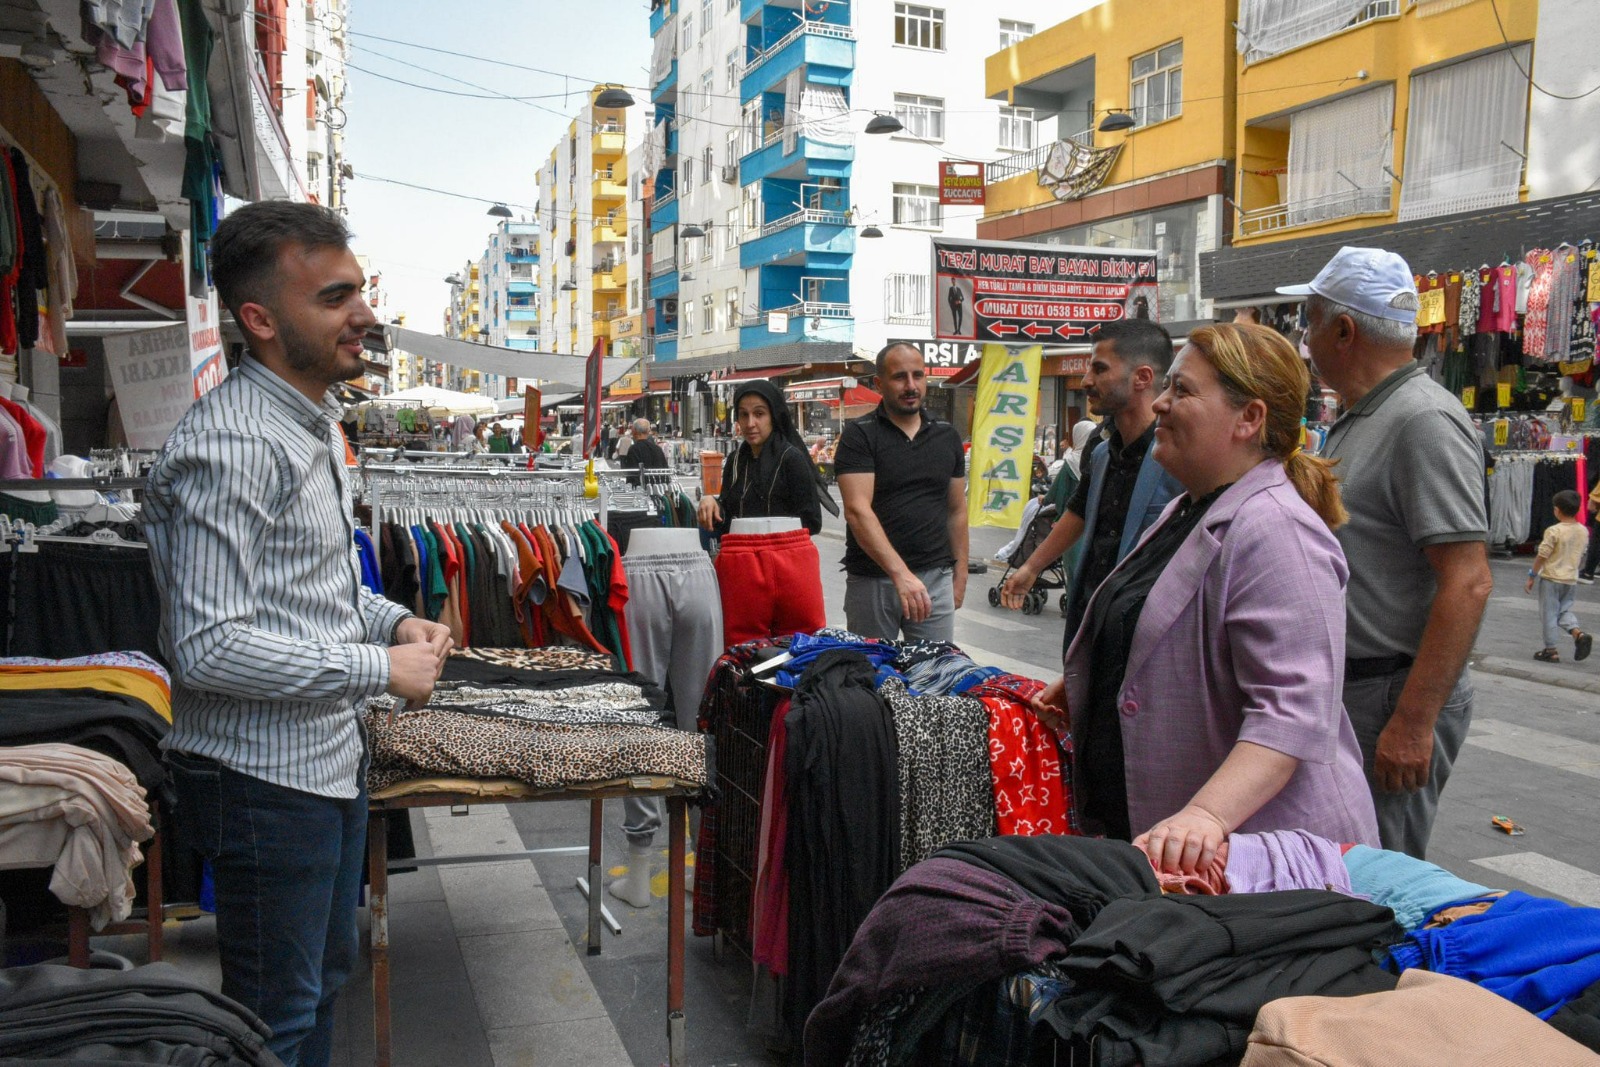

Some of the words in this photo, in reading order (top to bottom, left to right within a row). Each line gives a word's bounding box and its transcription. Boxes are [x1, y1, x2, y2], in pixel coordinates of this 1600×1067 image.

[938, 249, 977, 270] TERZİ
[980, 253, 1026, 272] MURAT
[1029, 256, 1055, 274] BAY
[1058, 257, 1099, 276] BAYAN
[1101, 258, 1136, 278] DİKİM
[977, 280, 989, 289] HER
[990, 280, 1007, 291] TÜRLÜ
[983, 302, 1018, 314] MURAT
[1021, 303, 1045, 316] USTA
[1047, 305, 1070, 317] 0538
[1073, 306, 1091, 318] 581
[1093, 307, 1105, 318] 64
[1108, 307, 1118, 318] 35
[982, 344, 1030, 512] ARŞAF
